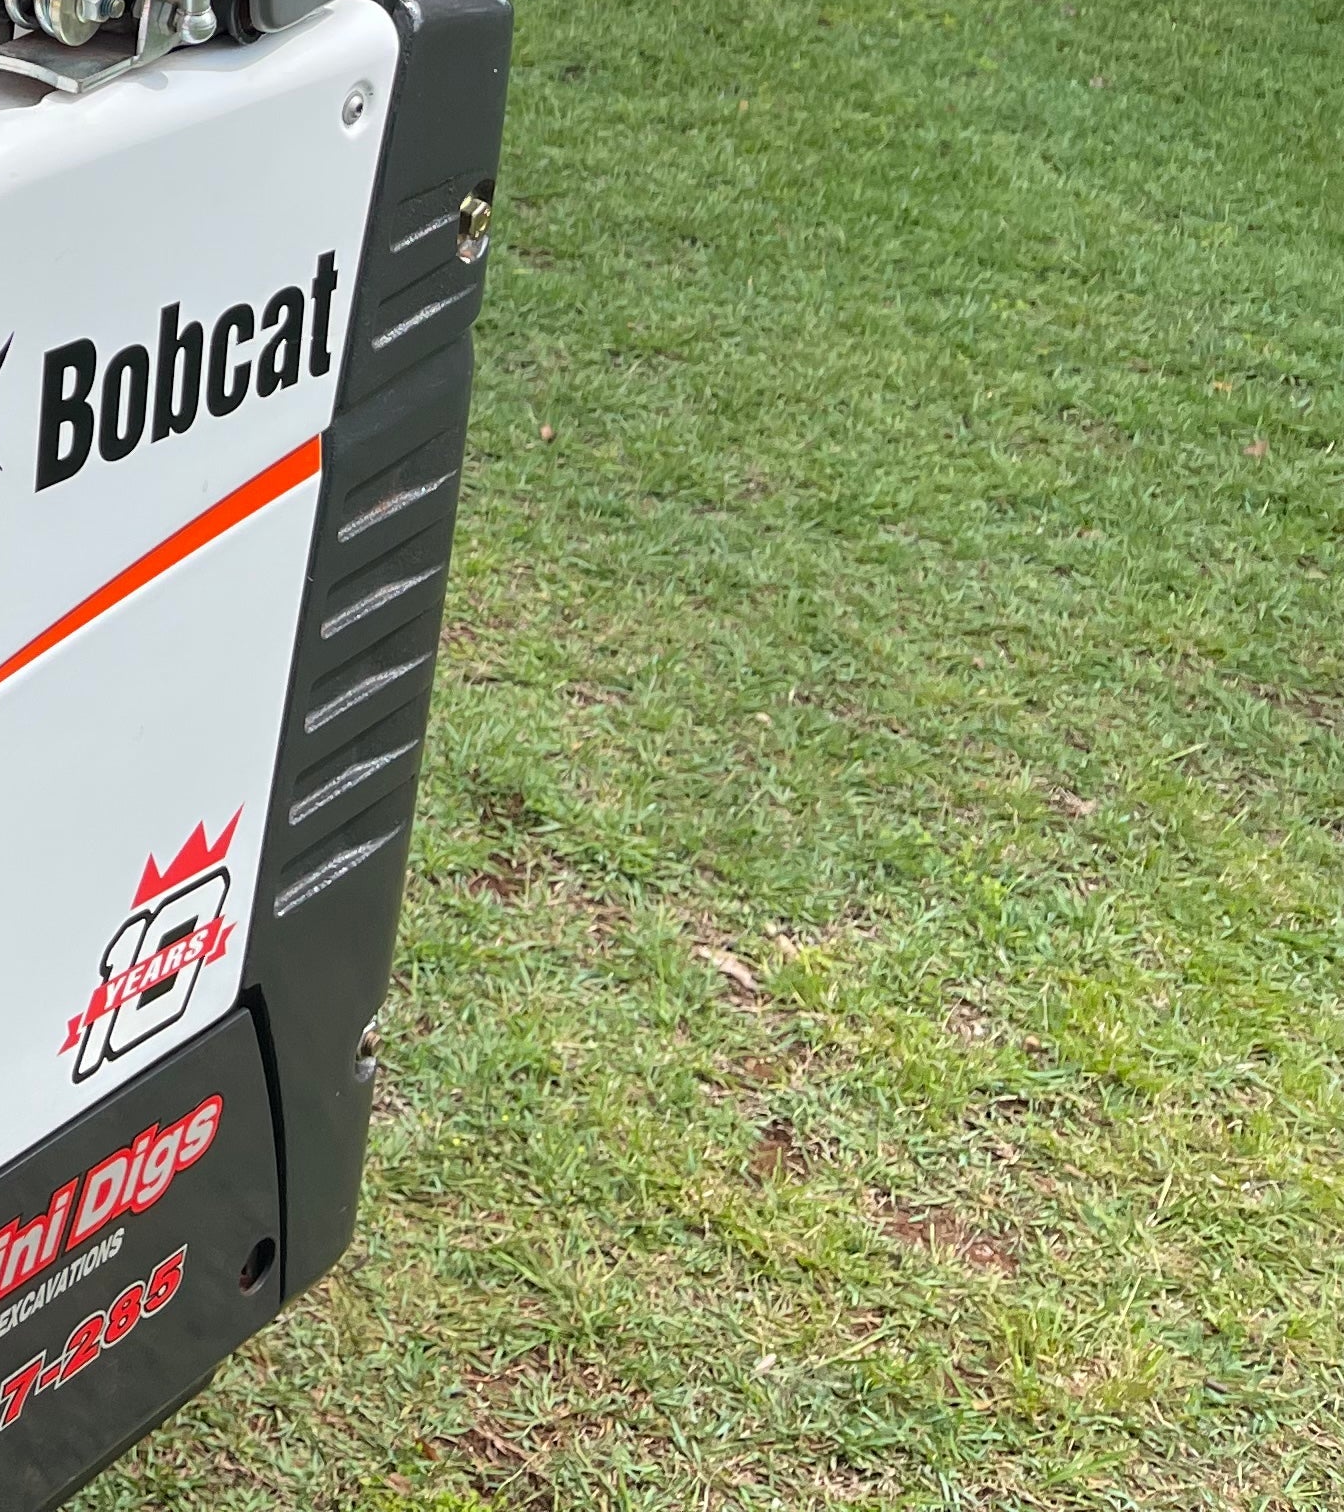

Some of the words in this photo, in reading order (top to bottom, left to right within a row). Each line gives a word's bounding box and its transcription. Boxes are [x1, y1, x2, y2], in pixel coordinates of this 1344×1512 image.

[34, 250, 338, 493] Bobcat
[72, 865, 230, 1085] 10
[103, 928, 210, 1011] YEARS
[67, 1094, 222, 1250] Digs
